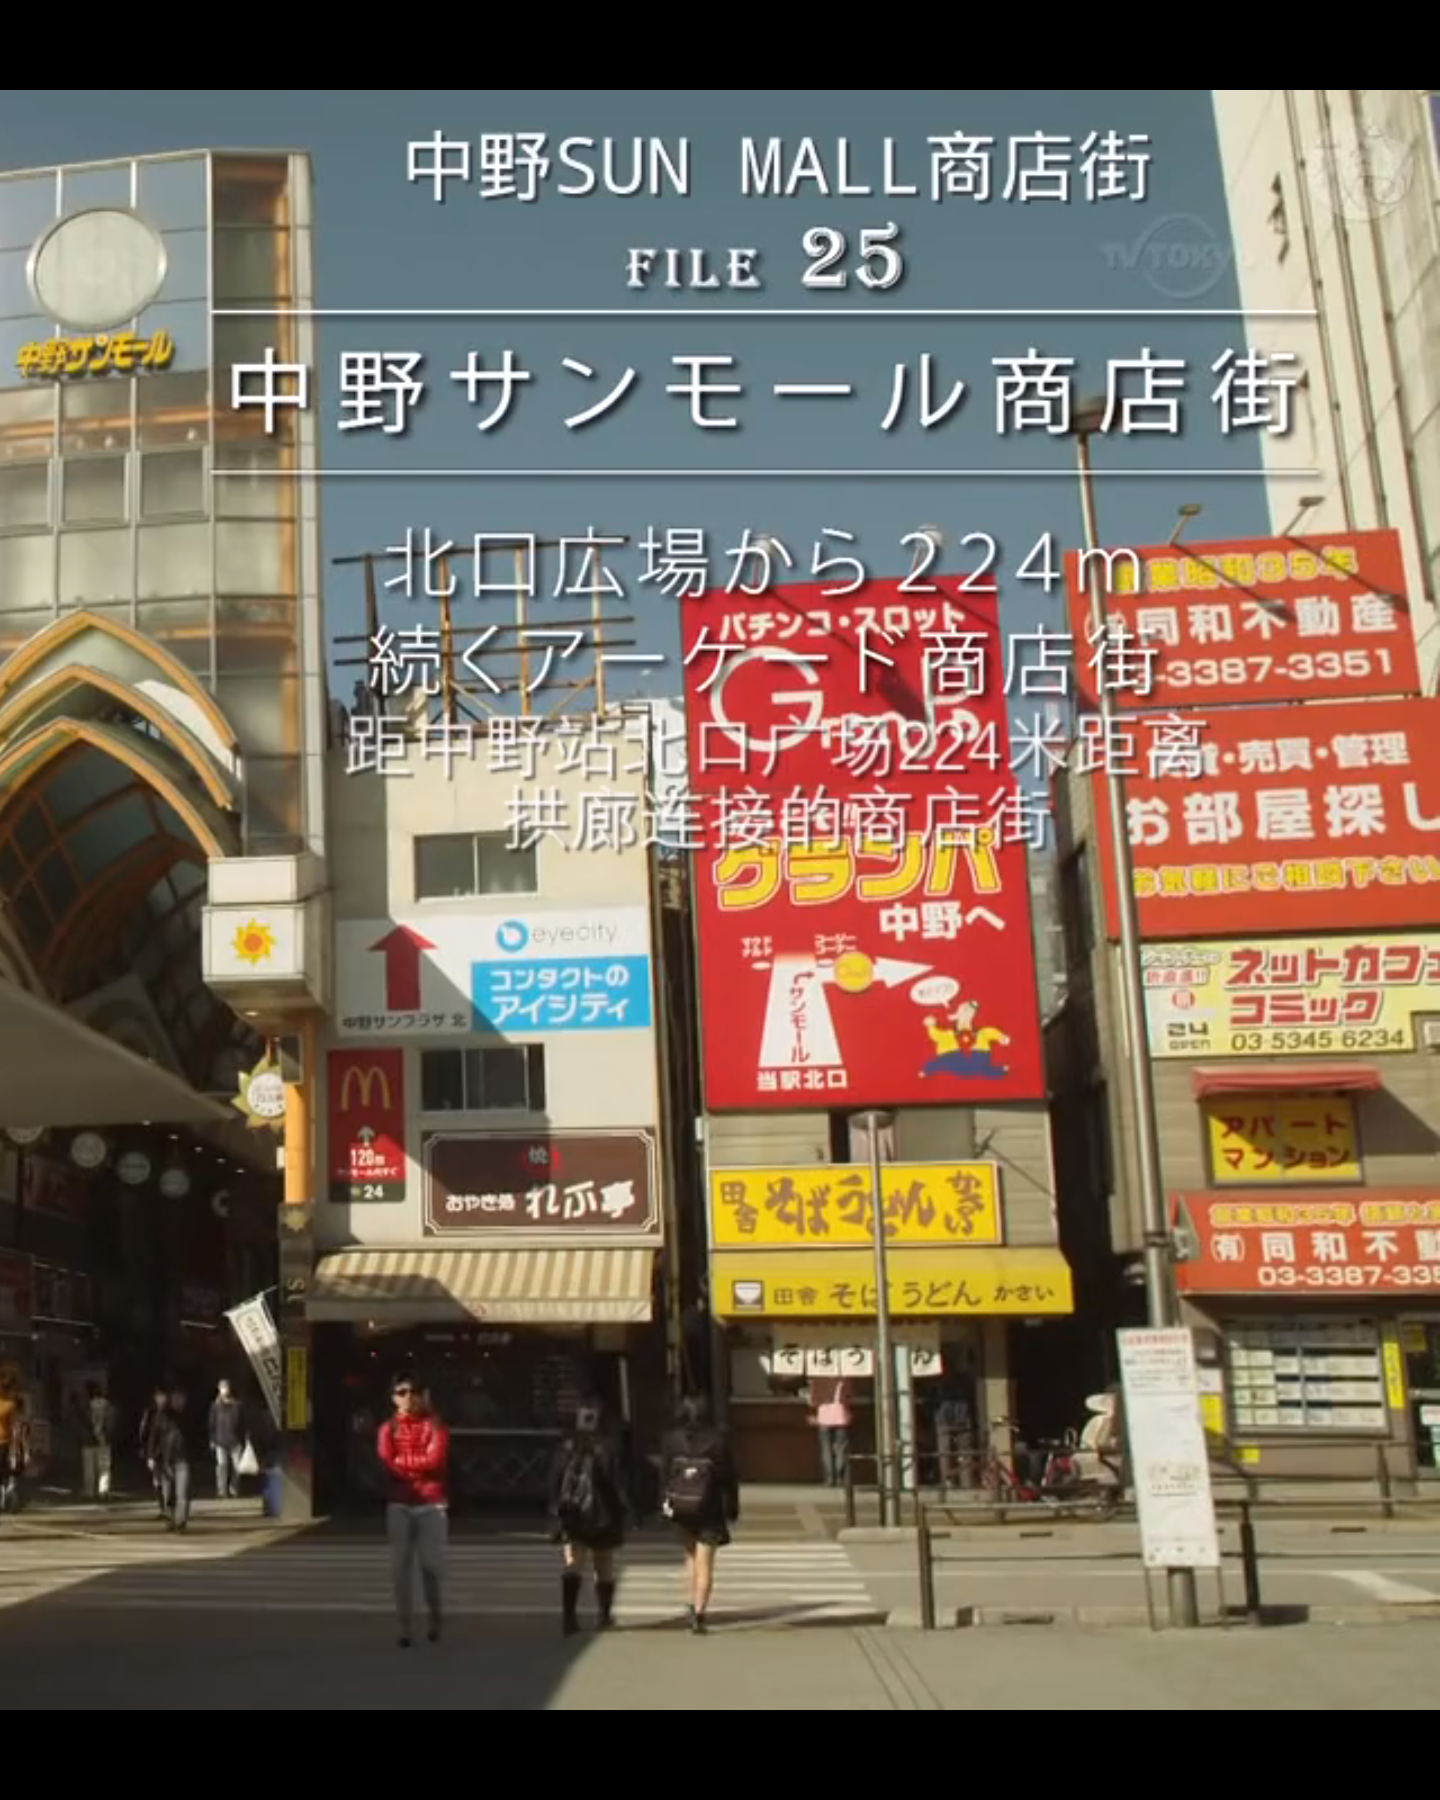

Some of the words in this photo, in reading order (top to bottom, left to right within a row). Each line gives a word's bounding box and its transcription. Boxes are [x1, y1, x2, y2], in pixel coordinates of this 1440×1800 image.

[17, 328, 176, 379] 中野サンモール
[1127, 782, 1440, 846] お部屋探し
[713, 824, 1002, 911] グランパ
[531, 924, 619, 944] eyecity
[879, 900, 1006, 942] 中野へ
[490, 963, 631, 991] コンタクトの
[489, 993, 631, 1027] アイシティ
[1230, 990, 1382, 1026] コミック
[790, 987, 811, 1063] サンモール
[1231, 1032, 1263, 1051] 03
[1271, 1031, 1334, 1050] 5345
[1341, 1029, 1405, 1048] 6234
[757, 1069, 848, 1092] 当駅北口
[1221, 1113, 1348, 1139] アパート
[1221, 1146, 1351, 1171] マンション
[363, 1184, 385, 1199] 24
[719, 1181, 759, 1235] 田舎
[773, 1288, 818, 1306] 田舎
[903, 1280, 981, 1308] うどん
[993, 1284, 1055, 1303] かさい
[779, 1346, 935, 1368] そばうん
